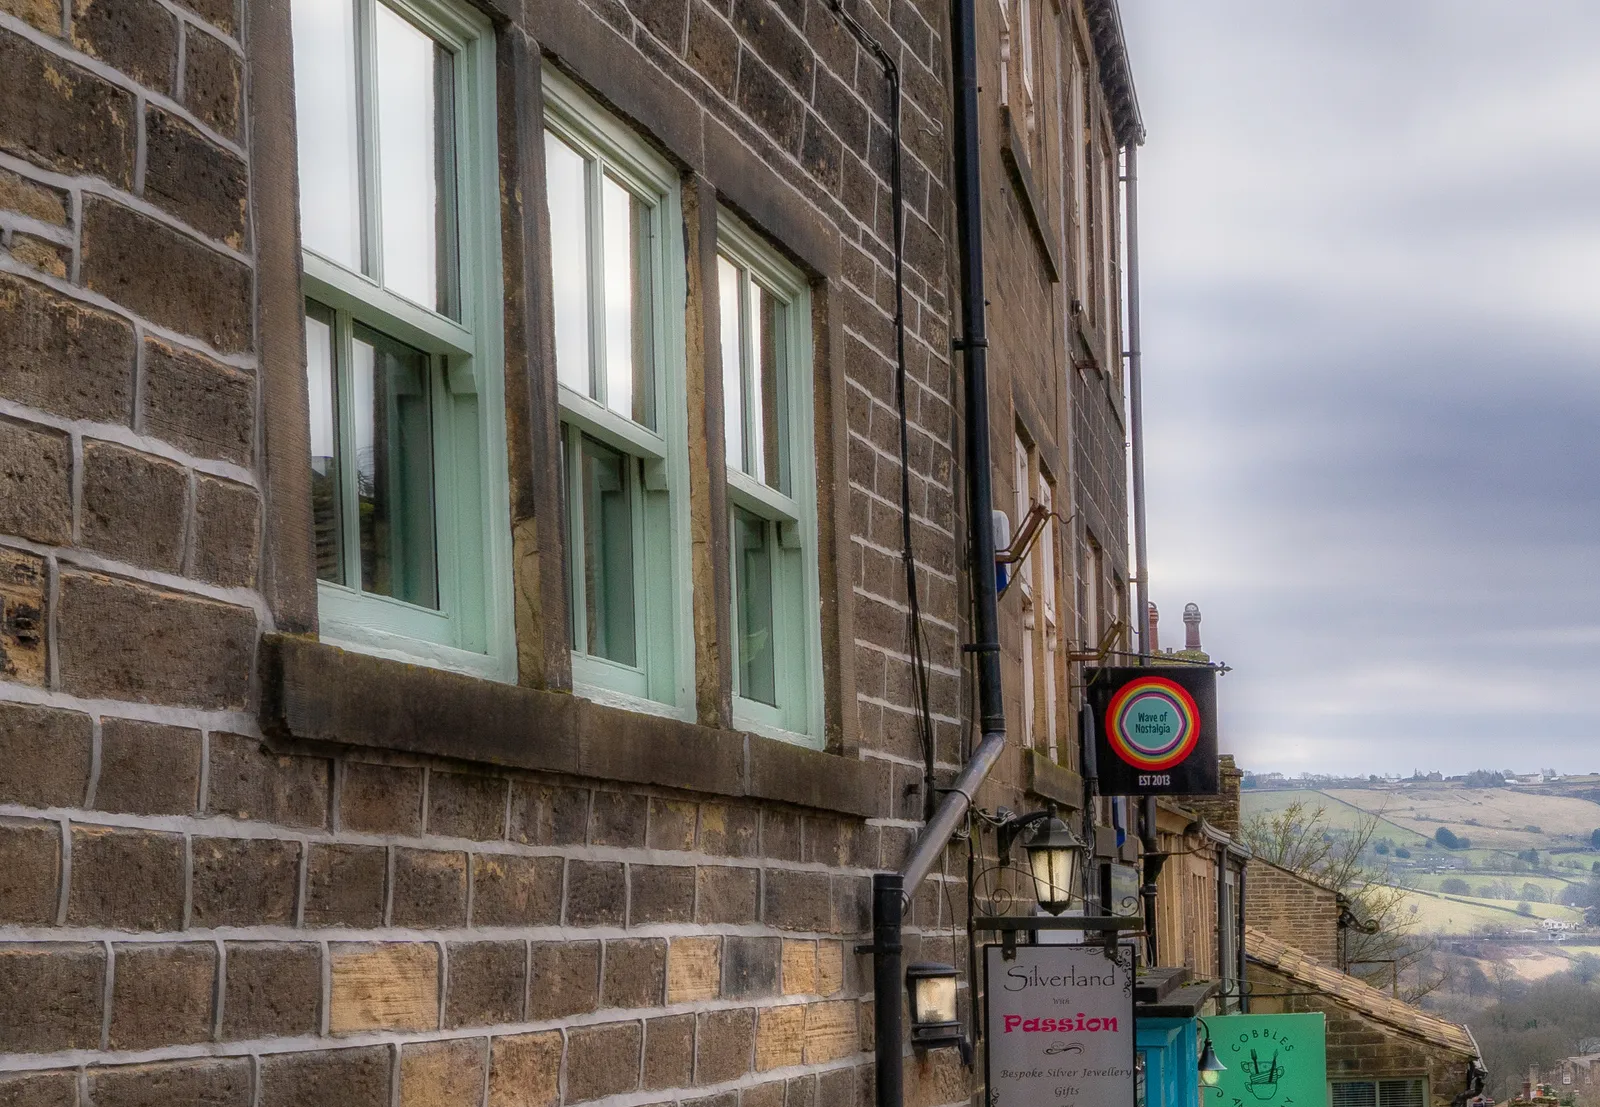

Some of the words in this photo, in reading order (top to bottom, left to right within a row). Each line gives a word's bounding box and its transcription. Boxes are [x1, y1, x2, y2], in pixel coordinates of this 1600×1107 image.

[1138, 712, 1158, 722] Wave
[1160, 711, 1168, 722] of
[1135, 724, 1171, 735] Nostalgia
[1138, 775, 1151, 786] EST
[1152, 774, 1171, 786] 2013
[1003, 965, 1115, 992] Silverland
[1003, 1012, 1119, 1034] Passion
[1231, 1028, 1294, 1052] COBBLES
[1000, 1067, 1043, 1082] Bespoke
[1046, 1066, 1079, 1078] Silver
[1081, 1066, 1132, 1079] Jewellery
[1054, 1086, 1079, 1098] Gifts
